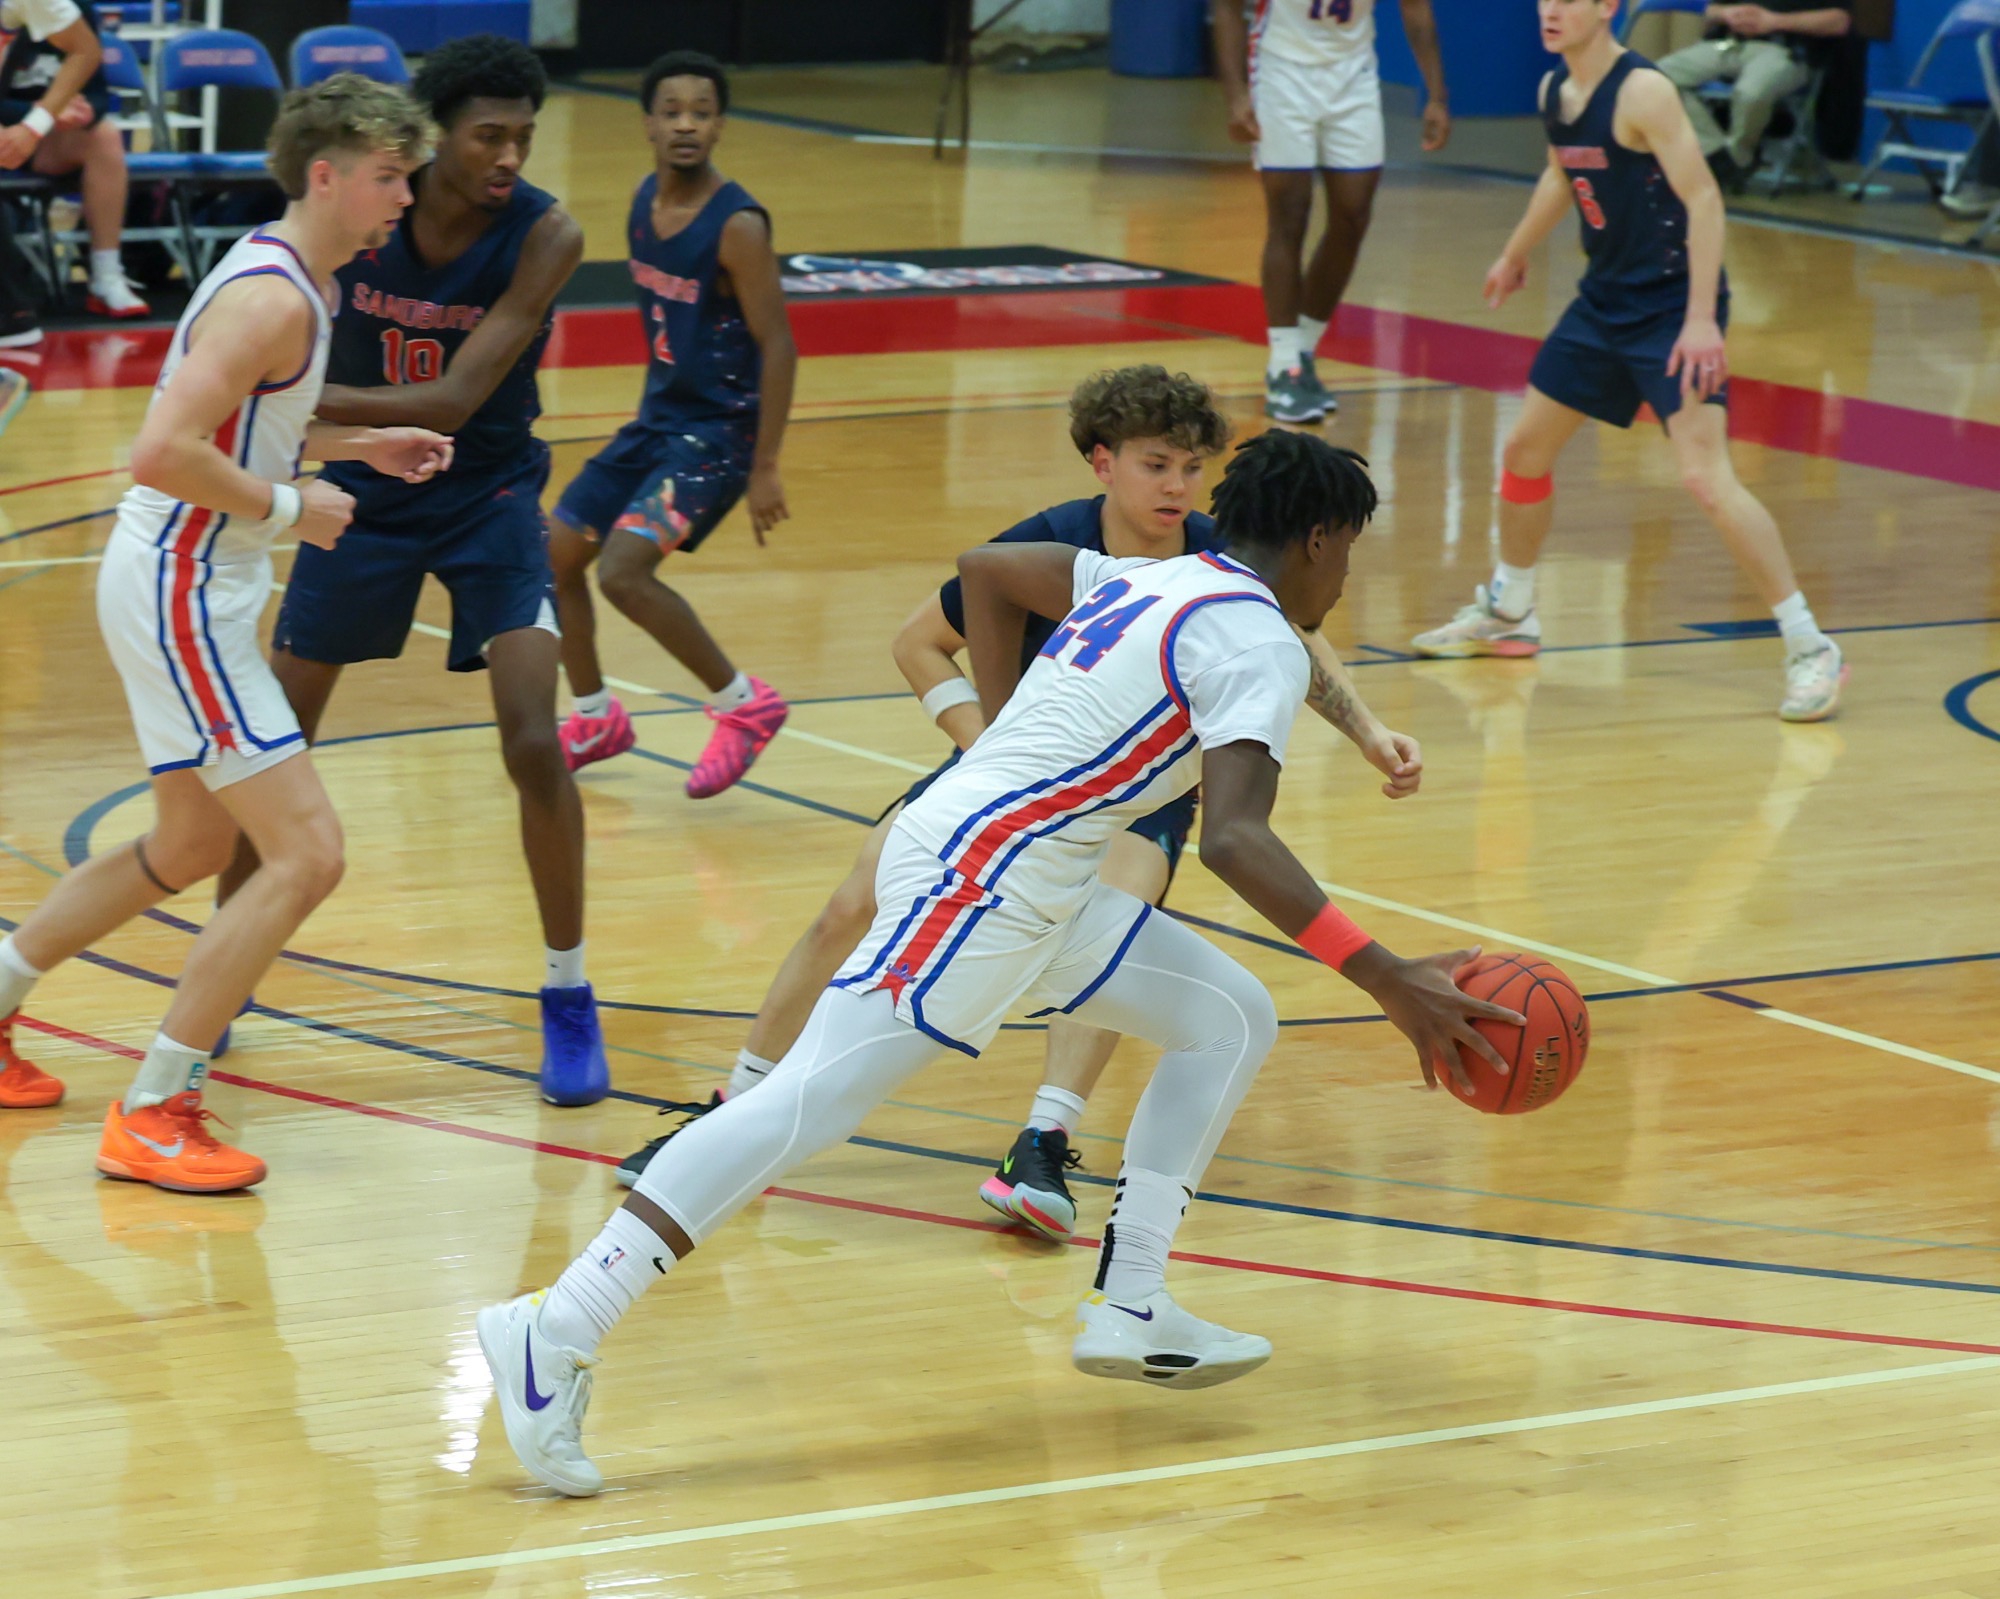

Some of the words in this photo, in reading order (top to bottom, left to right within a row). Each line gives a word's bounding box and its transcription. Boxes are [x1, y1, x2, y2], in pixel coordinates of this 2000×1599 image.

[1573, 176, 1606, 230] 6
[381, 327, 444, 384] 10
[1039, 577, 1164, 673] 24
